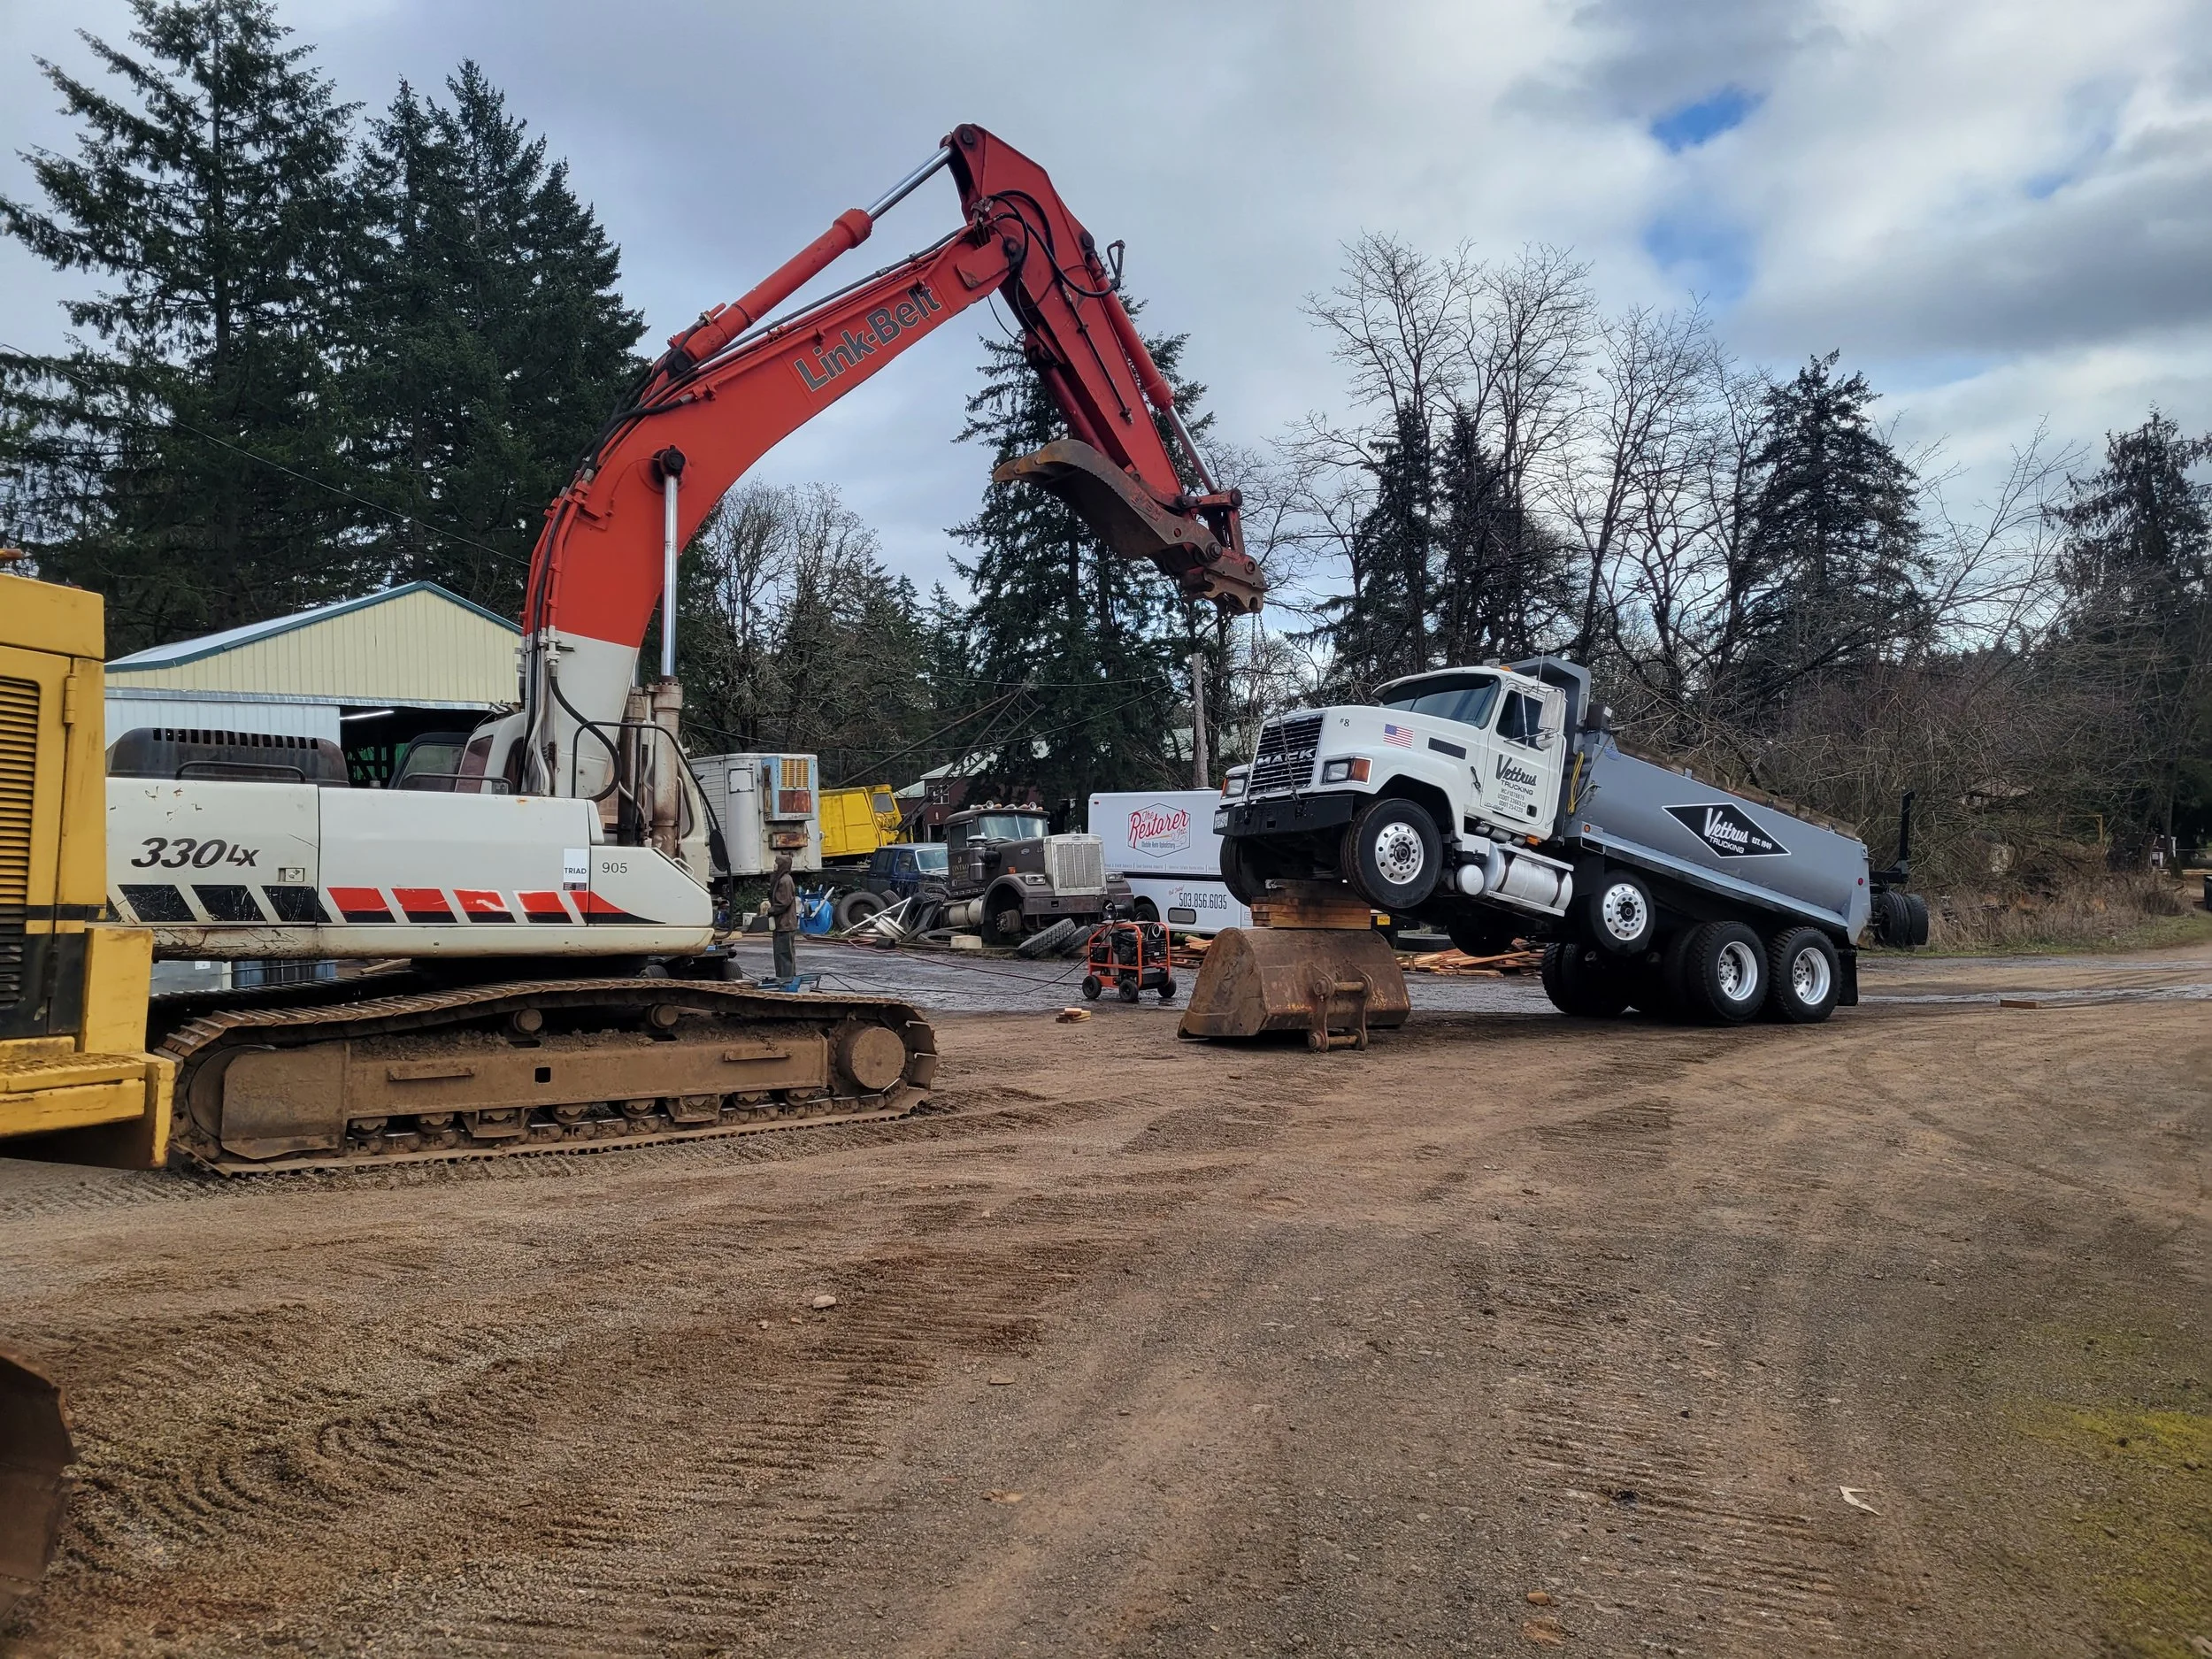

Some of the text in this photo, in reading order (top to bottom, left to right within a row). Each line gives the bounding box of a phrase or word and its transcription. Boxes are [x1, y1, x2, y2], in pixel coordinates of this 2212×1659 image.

[794, 288, 942, 392] Link-Belt
[1340, 718, 1350, 727] #8
[1256, 749, 1316, 765] MACK
[1496, 754, 1537, 786] Vettrus
[1501, 780, 1534, 795] TRUCKING
[1142, 811, 1154, 822] The
[1129, 810, 1190, 849] Restorer
[1704, 808, 1748, 842] Vettrus
[1709, 836, 1745, 854] TRUCKING
[1761, 841, 1772, 849] 1949
[602, 862, 628, 874] 905
[1179, 893, 1227, 910] 503.856.6035
